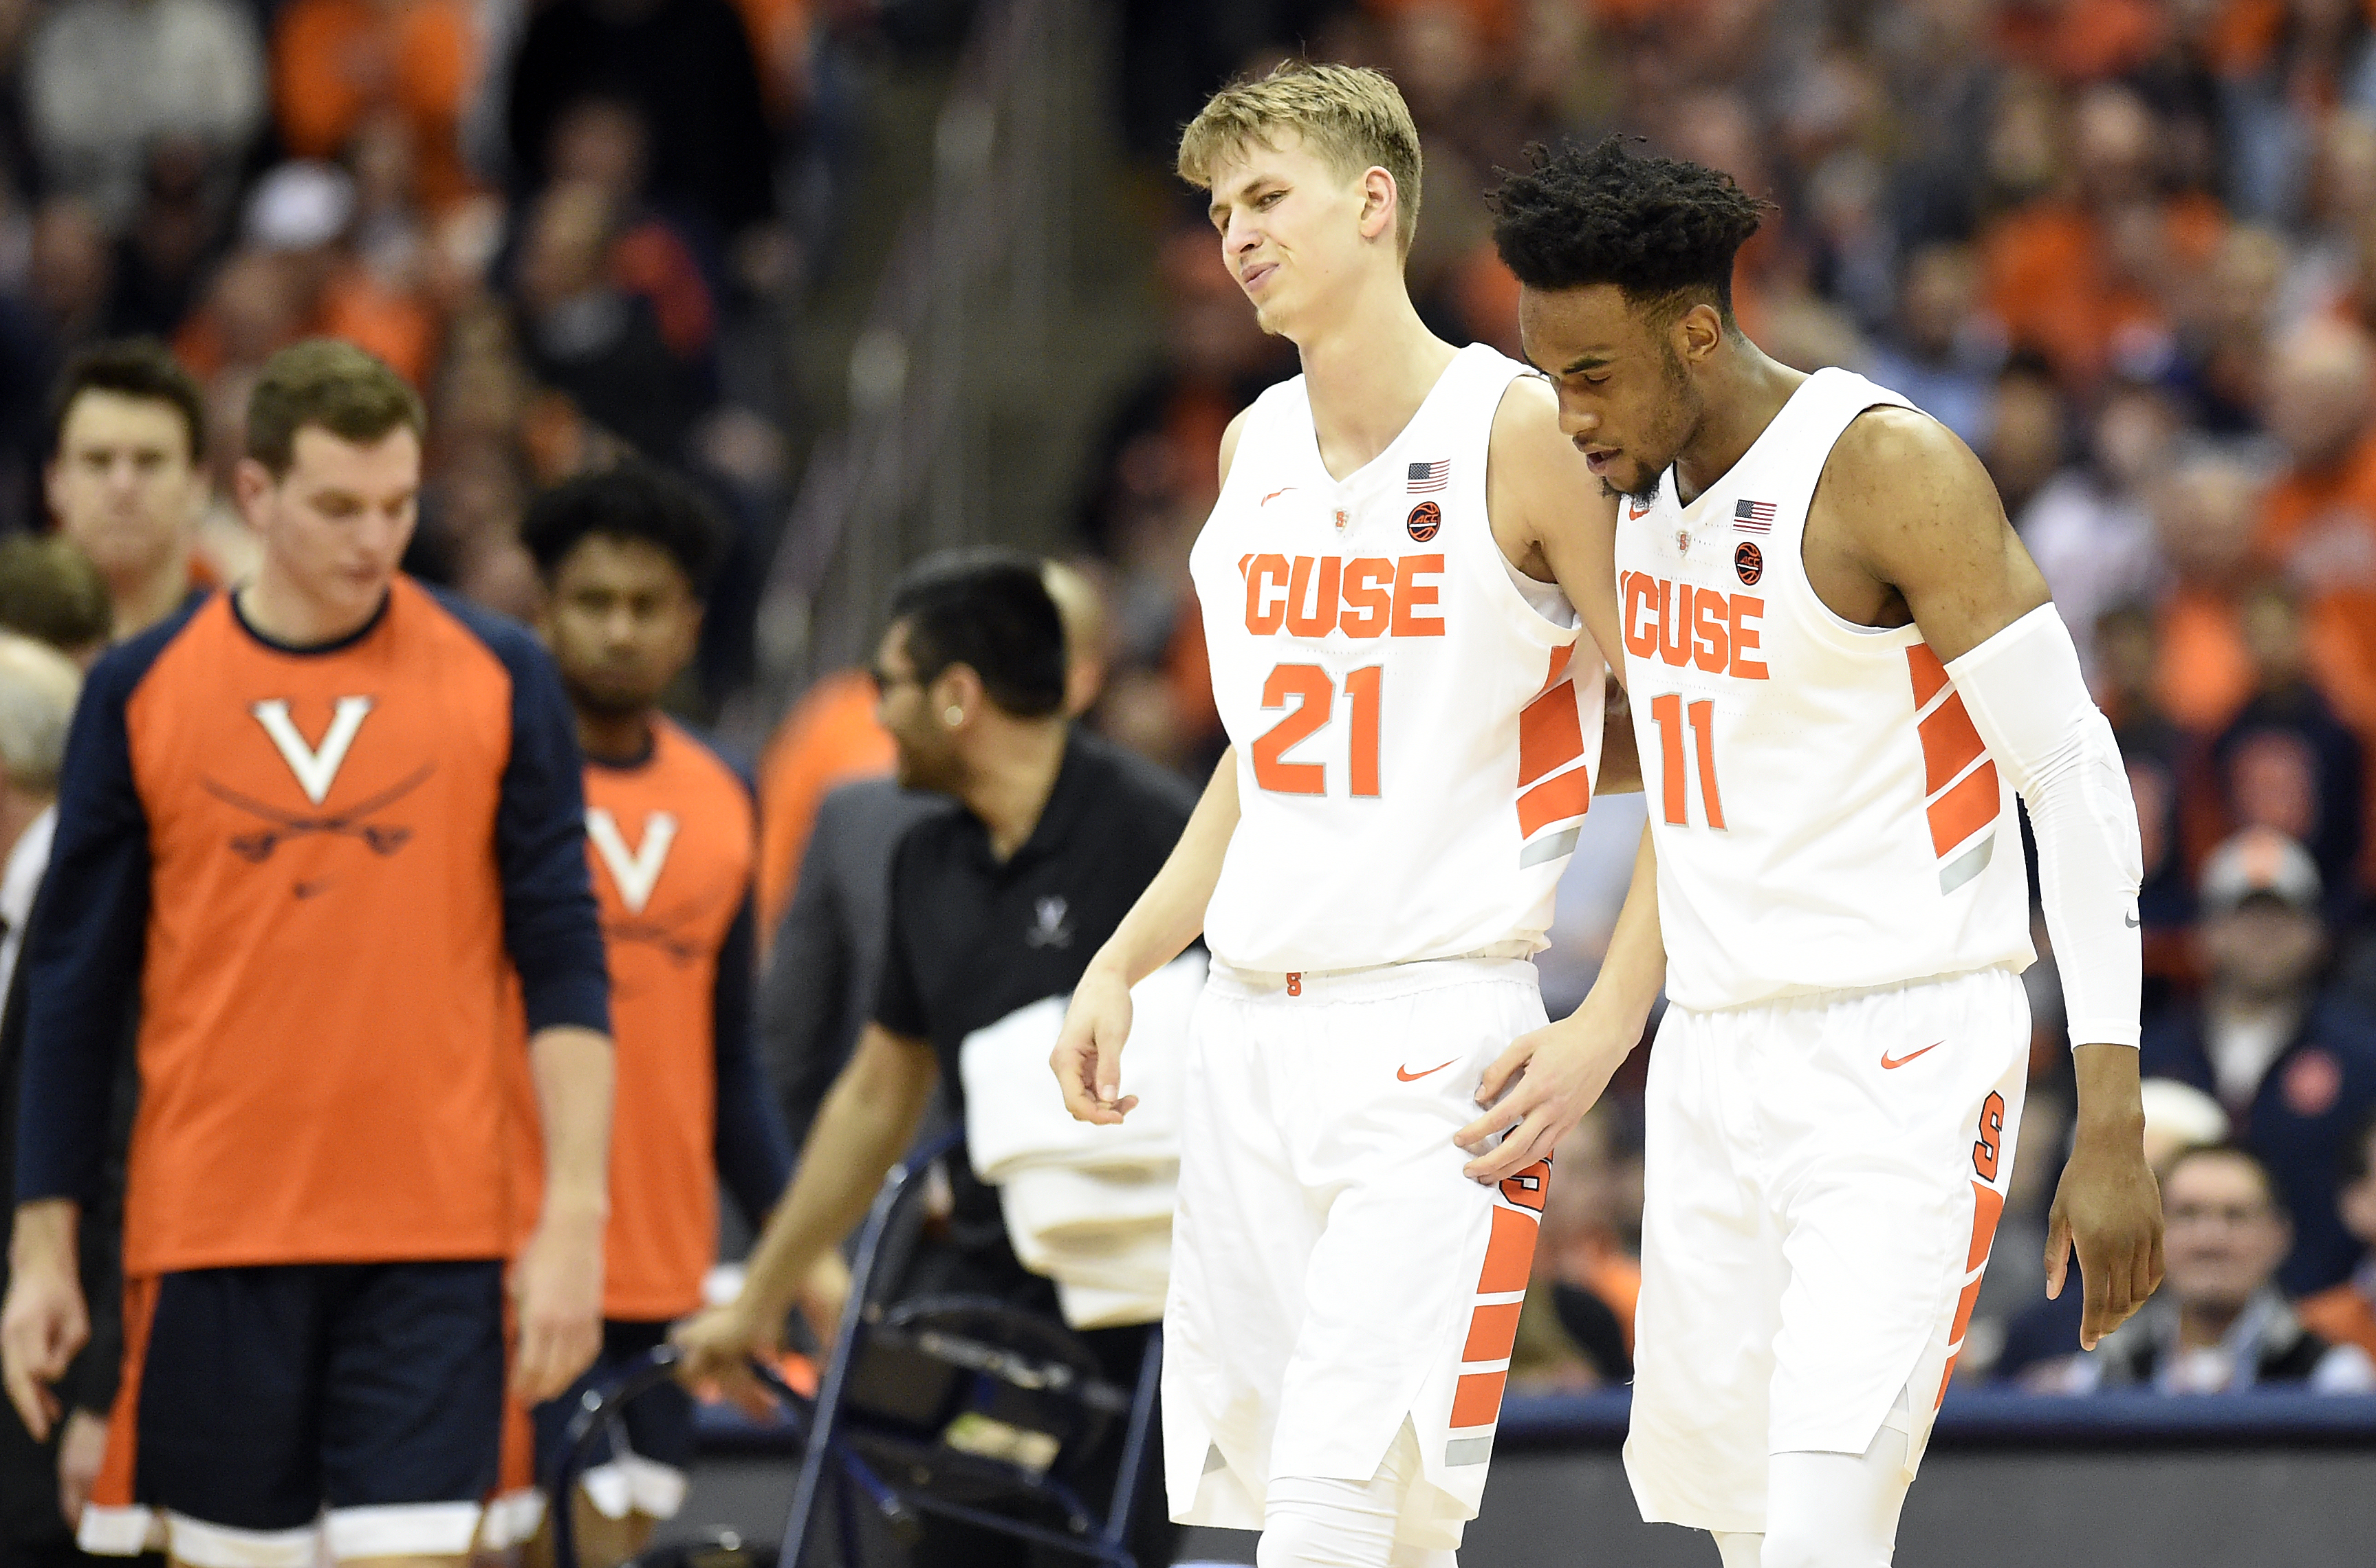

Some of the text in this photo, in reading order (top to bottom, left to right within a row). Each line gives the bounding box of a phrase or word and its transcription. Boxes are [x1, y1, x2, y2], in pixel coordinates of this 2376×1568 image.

[1413, 514, 1439, 523] ACC
[1739, 556, 1761, 567] ACC
[1238, 554, 1445, 638] 'CUSE
[250, 694, 375, 805] V
[1250, 662, 1384, 798] 21
[1650, 691, 1728, 833] 11
[586, 806, 678, 913] V
[1286, 972, 1302, 997] S
[1972, 1090, 2004, 1183] S
